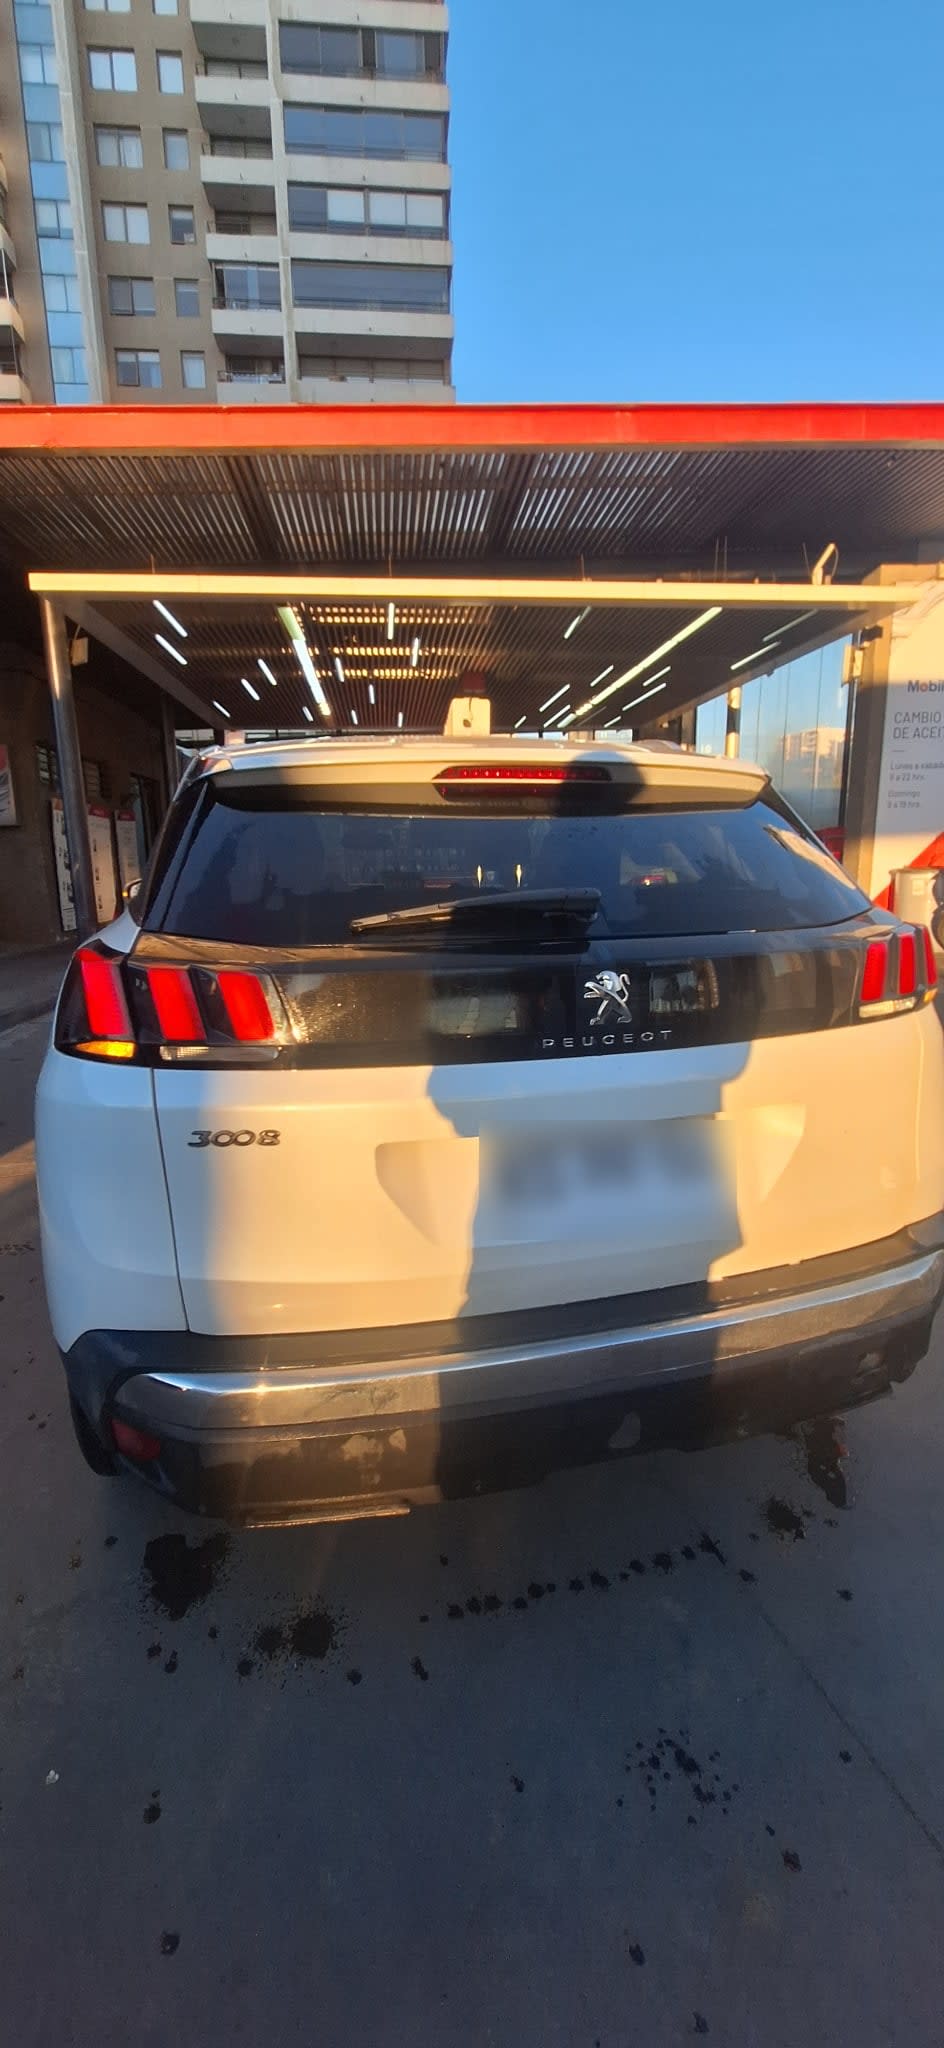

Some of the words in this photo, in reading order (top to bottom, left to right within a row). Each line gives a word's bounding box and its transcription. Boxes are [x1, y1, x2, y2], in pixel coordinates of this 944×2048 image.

[894, 712, 941, 723] CAMBIO
[893, 727, 909, 738] DE
[542, 1030, 672, 1048] PEUGEOT
[187, 1129, 281, 1148] 3008
